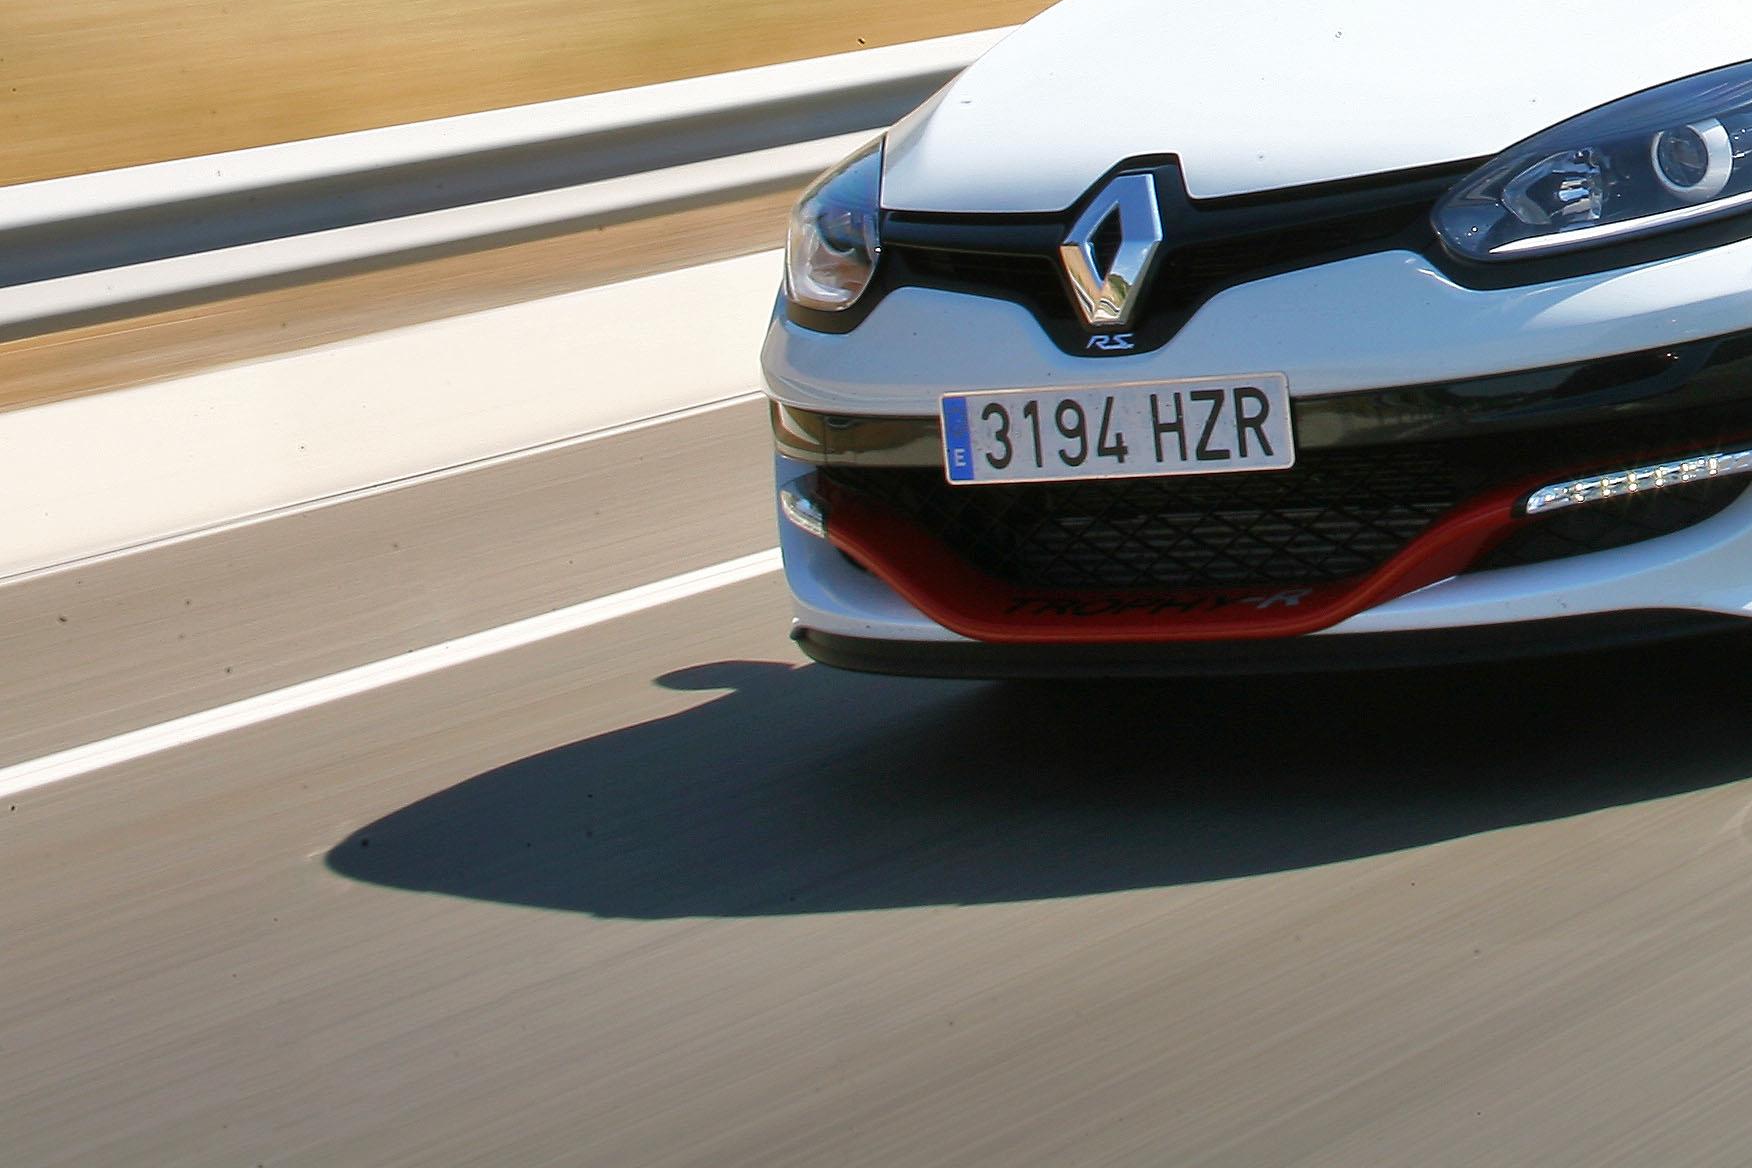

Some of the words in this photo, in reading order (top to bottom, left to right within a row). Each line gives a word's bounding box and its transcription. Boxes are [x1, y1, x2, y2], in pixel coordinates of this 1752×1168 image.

[1086, 333, 1135, 350] RS
[981, 396, 1128, 469] 3194
[1150, 387, 1274, 462] HZR
[954, 447, 967, 467] E
